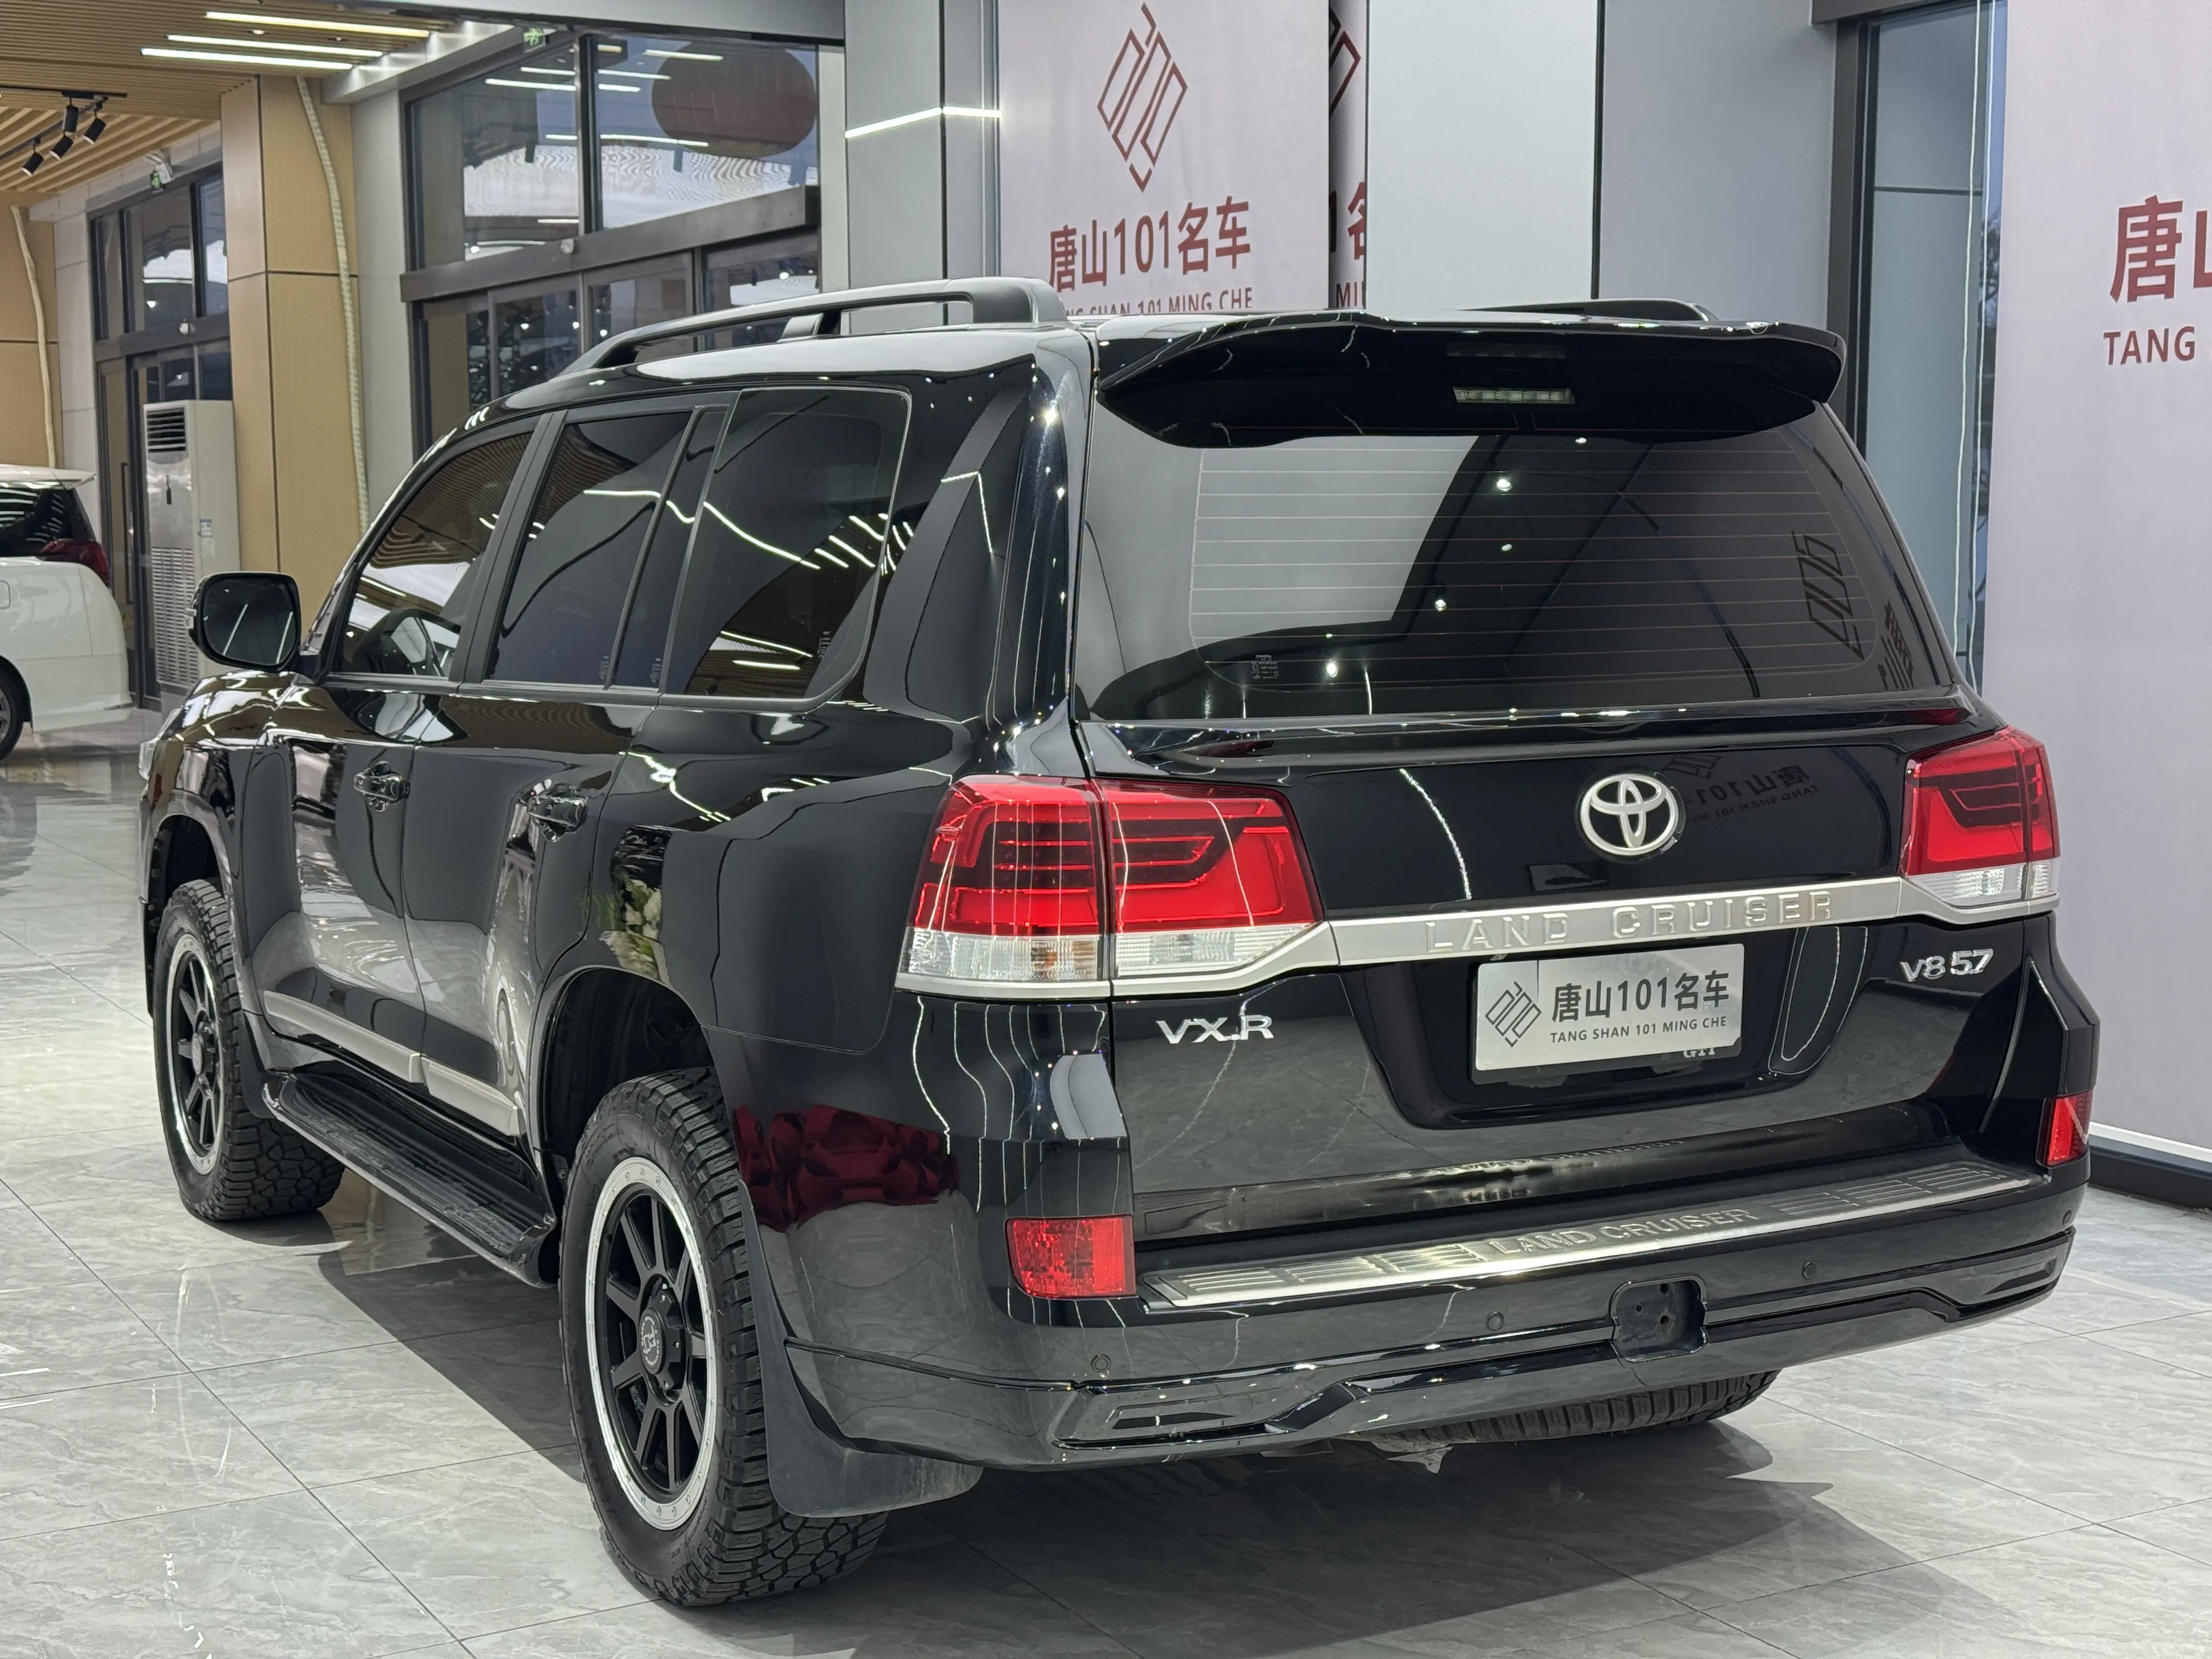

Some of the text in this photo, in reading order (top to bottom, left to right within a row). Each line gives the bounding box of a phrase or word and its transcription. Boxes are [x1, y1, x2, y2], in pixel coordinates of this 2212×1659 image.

[1049, 196, 1251, 293] 唐山101名车
[2109, 194, 2212, 303] 唐
[1169, 292, 1211, 312] MING
[1219, 287, 1253, 309] CHE
[2103, 326, 2196, 365] TANG
[1426, 890, 1833, 953] LAND CRUISER
[1551, 970, 1729, 1023] 唐山101名车
[1550, 1016, 1727, 1043] TANG SHAN 101 MING CHE
[1488, 1208, 1760, 1255] LAND CRUISER
